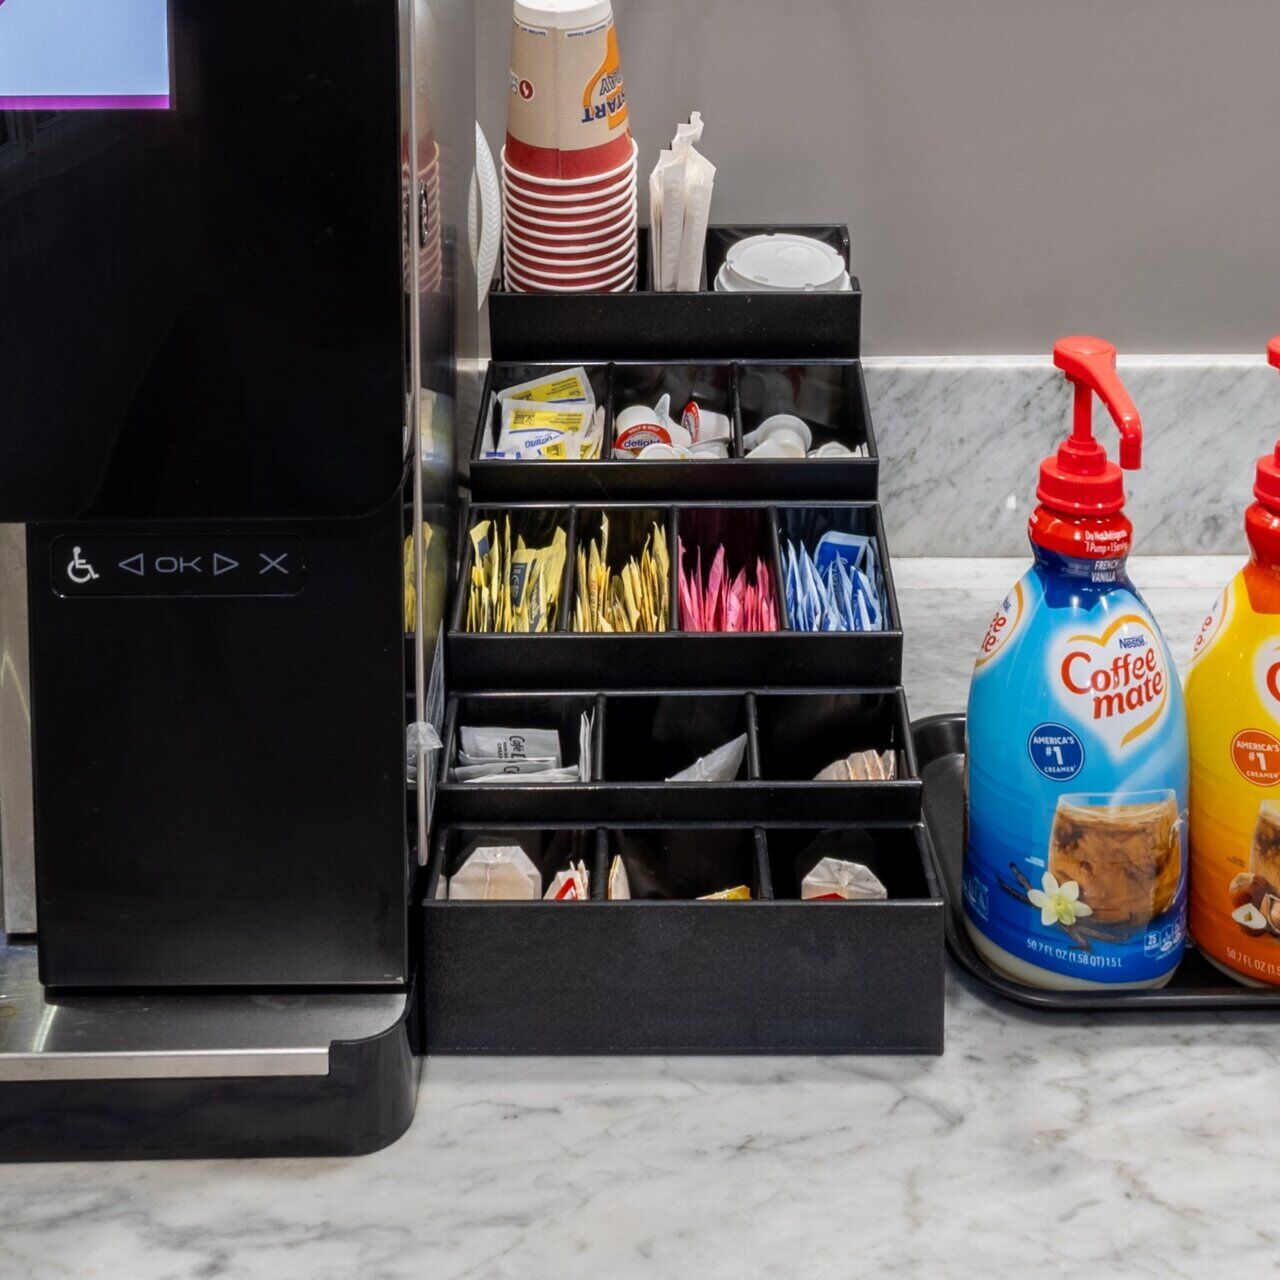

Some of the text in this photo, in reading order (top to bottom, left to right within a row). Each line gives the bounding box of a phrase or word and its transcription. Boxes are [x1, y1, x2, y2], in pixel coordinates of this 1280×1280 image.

[1090, 543, 1106, 555] Pump
[155, 556, 202, 573] OK
[1094, 560, 1119, 570] FRENCH
[1091, 571, 1116, 583] VANILLA
[1119, 635, 1145, 649] Nestlé
[1061, 648, 1156, 695] Coffee
[1093, 671, 1163, 719] mate
[1033, 735, 1075, 745] AMERICA'S
[1236, 740, 1280, 752] AMERICA'S
[1026, 938, 1043, 953] 50.7
[1044, 945, 1054, 958] FL
[1055, 948, 1067, 961] OZ
[1090, 955, 1105, 968] QT)
[1226, 946, 1242, 962] 50.7
[1243, 955, 1253, 968] FL
[1254, 958, 1265, 972] OZ
